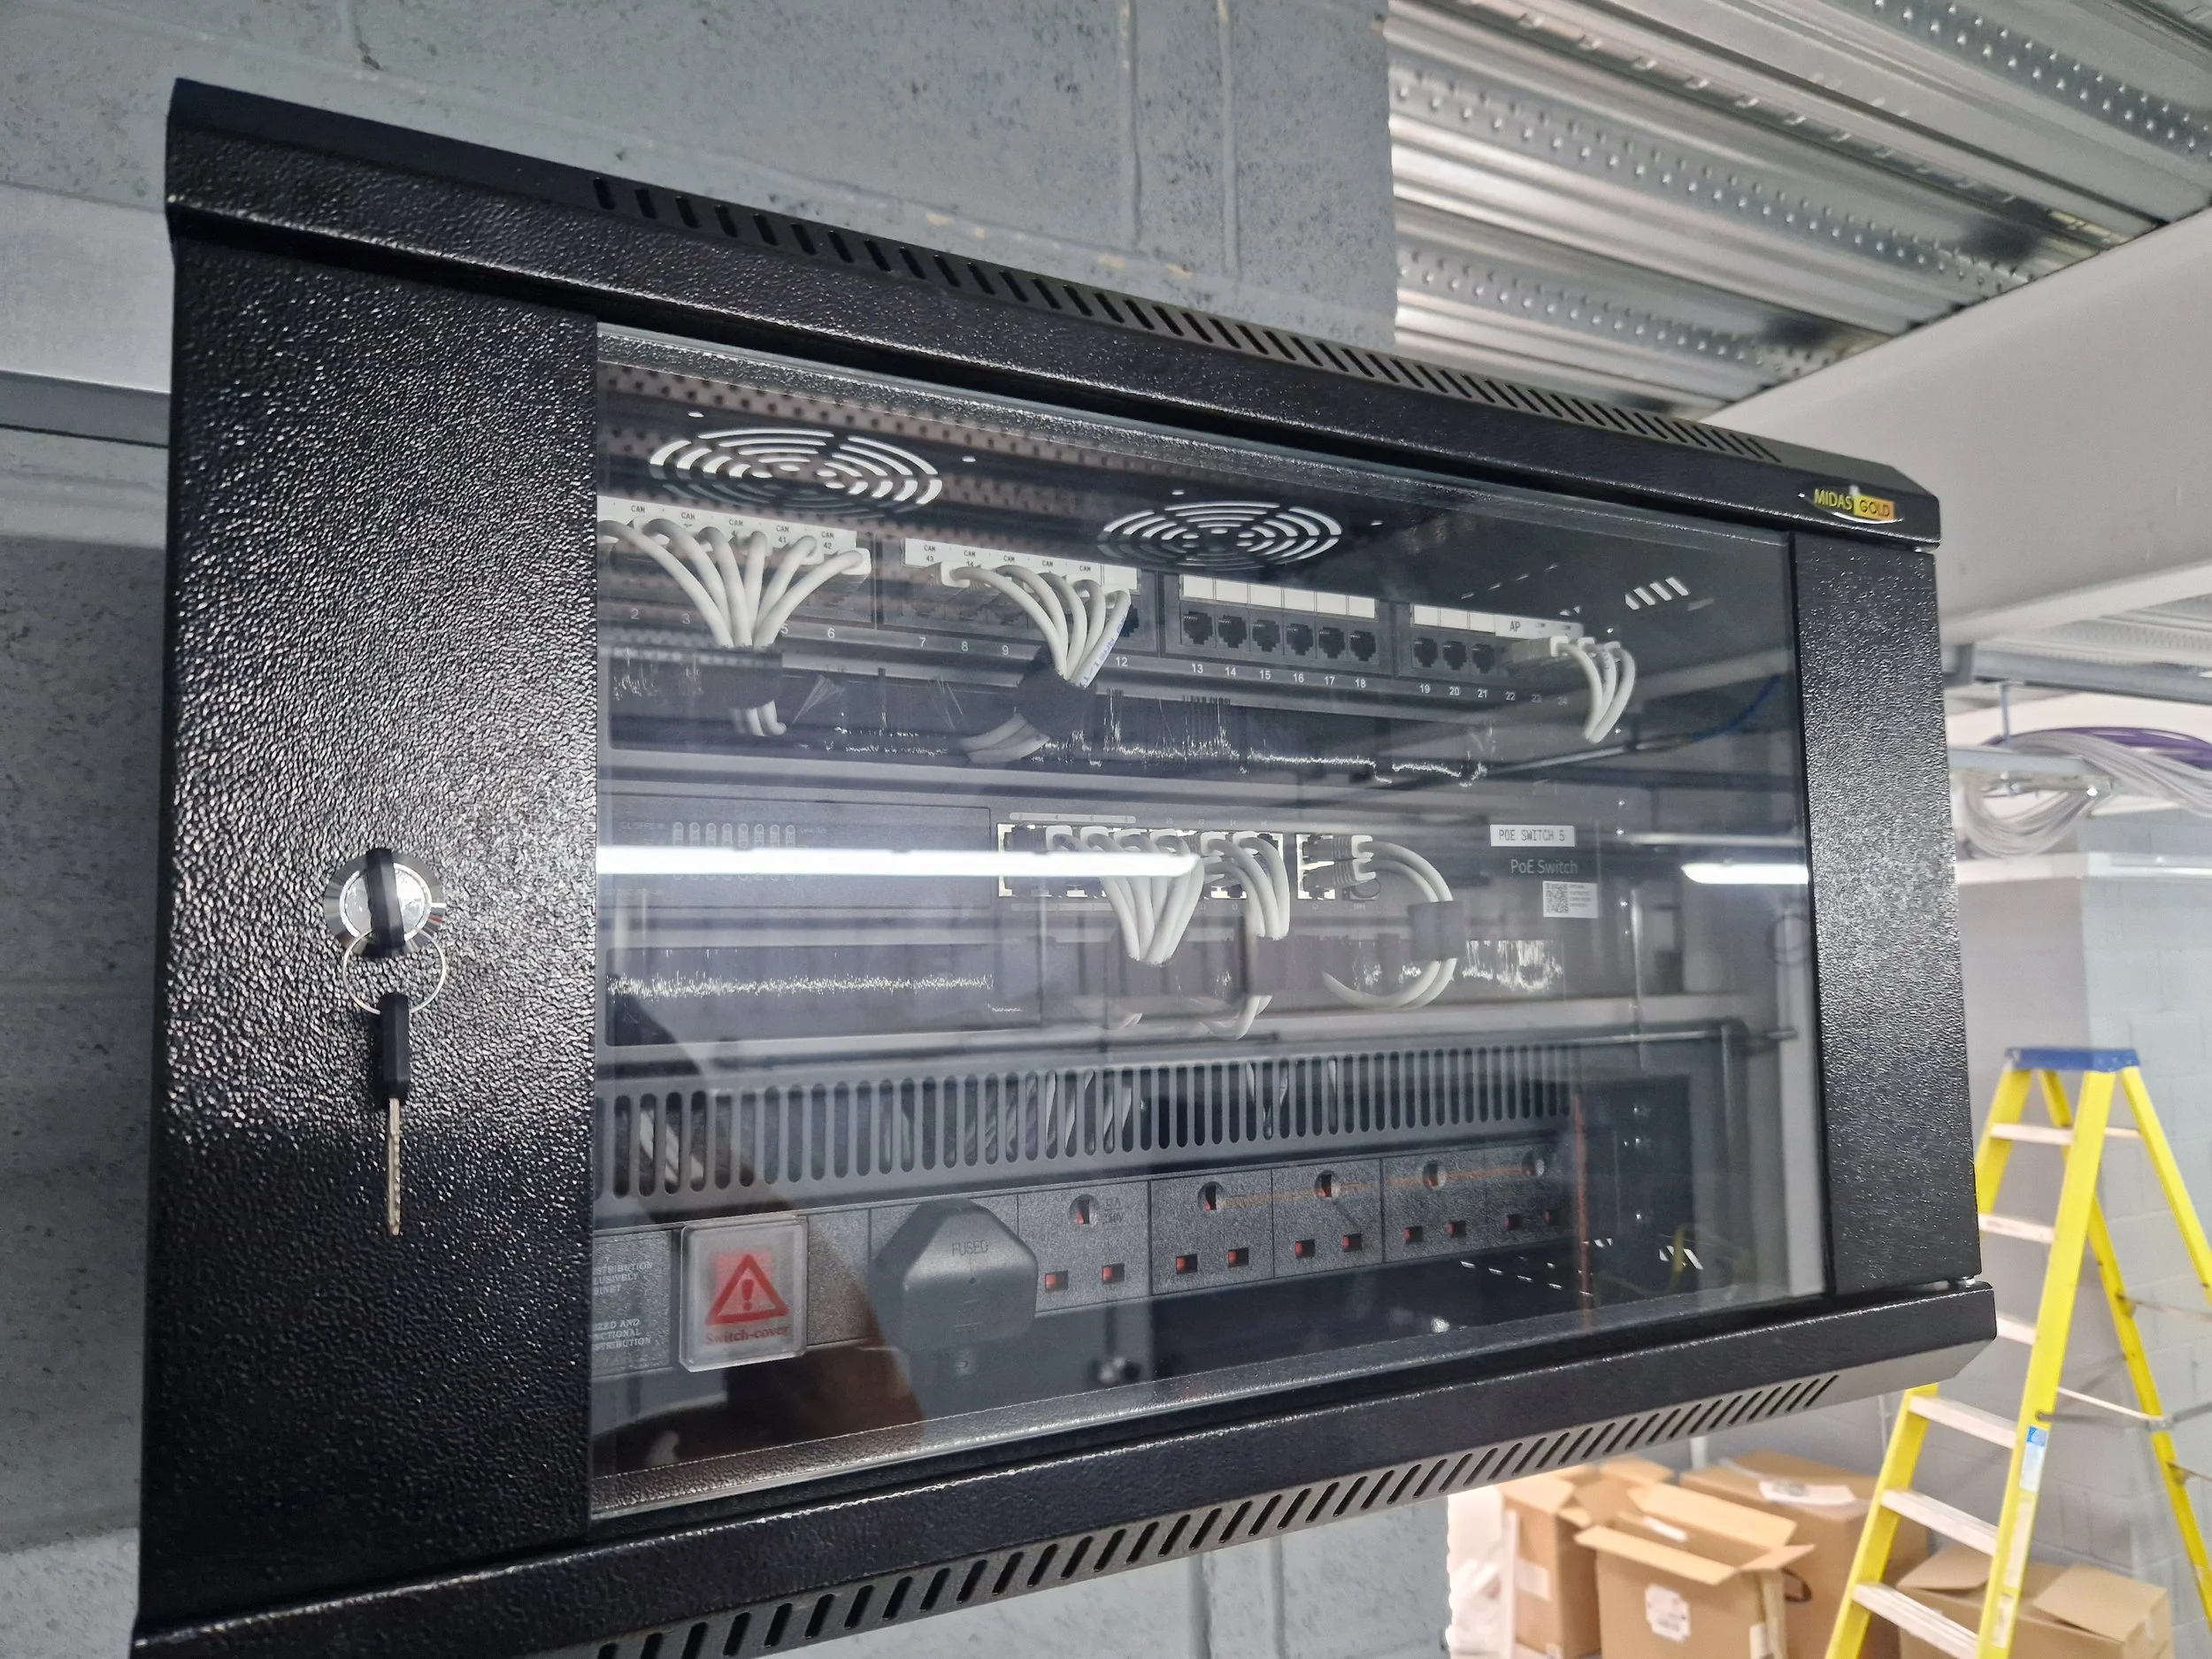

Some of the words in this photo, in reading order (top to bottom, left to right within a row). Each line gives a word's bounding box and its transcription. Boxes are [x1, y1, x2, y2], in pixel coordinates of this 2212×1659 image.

[1814, 488, 1854, 511] MIDAS
[1859, 499, 1891, 518] GOLD
[631, 608, 640, 619] 2
[681, 612, 691, 624] 3
[780, 623, 789, 634] 5
[1509, 620, 1521, 632] AP
[827, 626, 836, 639] 6
[919, 636, 927, 648] 7
[961, 641, 969, 652] 8
[1002, 645, 1010, 656] 9
[1116, 656, 1128, 667] 12
[1192, 664, 1204, 674] 13
[1225, 666, 1237, 678] 14
[1259, 669, 1271, 680] 15
[1293, 672, 1304, 683] 16
[1325, 675, 1335, 687] 17
[1355, 679, 1367, 688] 18
[1419, 684, 1431, 694] 19
[1449, 686, 1460, 697] 20
[1477, 688, 1488, 699] 21
[1505, 691, 1516, 702] 22
[1531, 694, 1542, 703] 23
[1557, 696, 1568, 706] 24
[1499, 829, 1516, 841] POE
[1522, 829, 1555, 842] SWITCH
[1559, 830, 1565, 842] 5
[1510, 858, 1535, 874] PoE
[1537, 859, 1578, 875] Switch
[952, 1240, 988, 1256] FUSED
[619, 1317, 640, 1328] AND
[706, 1325, 790, 1344] Switch-cover
